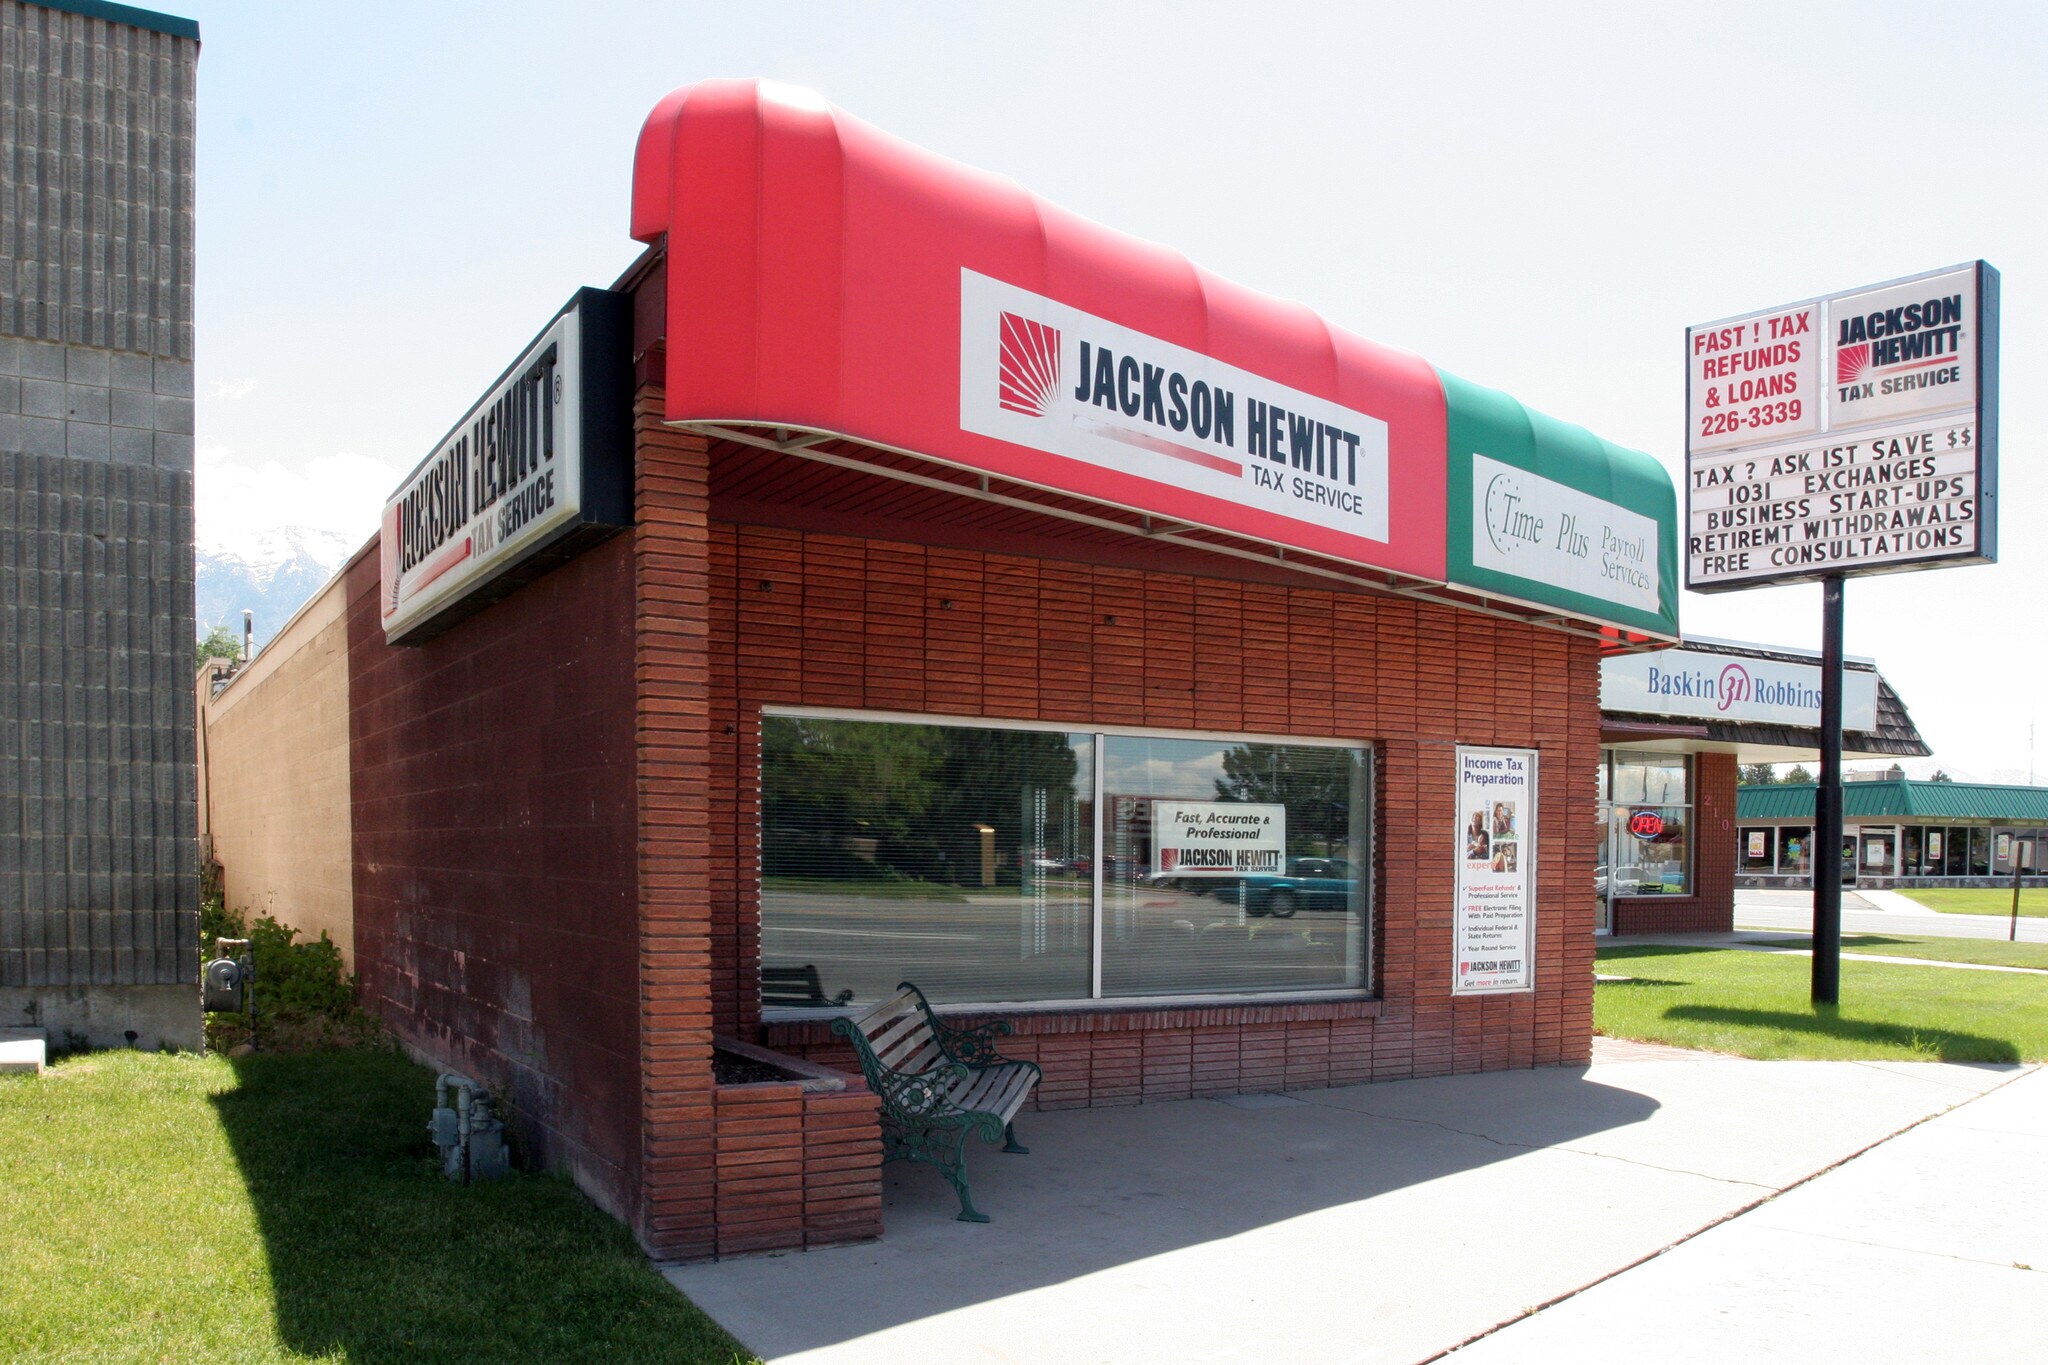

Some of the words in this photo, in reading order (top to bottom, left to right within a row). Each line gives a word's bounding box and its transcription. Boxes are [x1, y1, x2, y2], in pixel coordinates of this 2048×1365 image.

[1694, 326, 1745, 355] FAST
[1754, 322, 1759, 342] !
[1768, 312, 1810, 339] TAX
[1837, 295, 1961, 346] JACKSON
[1704, 341, 1800, 380] REFUNDS
[1872, 326, 1961, 367] HEWITT
[1729, 372, 1797, 405] LOANS
[1839, 380, 1874, 402] TAX
[1881, 366, 1959, 395] SERVICE
[1074, 340, 1234, 447] JACKSON
[1247, 398, 1360, 486] HEWITT
[1702, 400, 1801, 437] 226-3339
[401, 434, 468, 574] JACKSON
[472, 341, 557, 518] HEWITT
[1694, 466, 1734, 488] TAX
[1745, 463, 1756, 480] ?
[1770, 454, 1810, 476] ASK
[1872, 434, 1933, 460] SAVE
[1947, 428, 1971, 448] $$
[1804, 457, 1936, 494] EXCHANGES
[1251, 464, 1284, 492] TAX
[1293, 477, 1363, 515] SERVICE
[1707, 500, 1810, 530] BUSINESS
[1830, 478, 1963, 513] START-UPS
[470, 521, 494, 559] TAX
[497, 468, 554, 543] SERVICE
[1502, 493, 1543, 544] Time
[1556, 513, 1589, 558] Plus
[1690, 525, 1793, 554] RETIREMT
[1804, 500, 1973, 540] WITHDRAWALS
[1602, 526, 1644, 562] Payroll
[1704, 554, 1749, 574] FREE
[1770, 526, 1963, 566] CONSULTATIONS
[1601, 552, 1649, 590] Services
[1648, 667, 1714, 698] Baskin
[1718, 675, 1745, 711] 31
[1755, 678, 1821, 709] Robbins
[1464, 771, 1523, 787] Preparation
[1465, 756, 1502, 769] Income
[1506, 758, 1522, 770] Tax
[1175, 812, 1202, 824] Fast,
[1206, 812, 1259, 824] Accurate
[1186, 827, 1260, 839] Professional
[1631, 817, 1664, 833] OPEN
[1180, 849, 1232, 866] JACKSON
[1237, 850, 1279, 866] HEWITT
[1470, 961, 1497, 971] JACKSON
[1499, 960, 1521, 970] HEWITT
